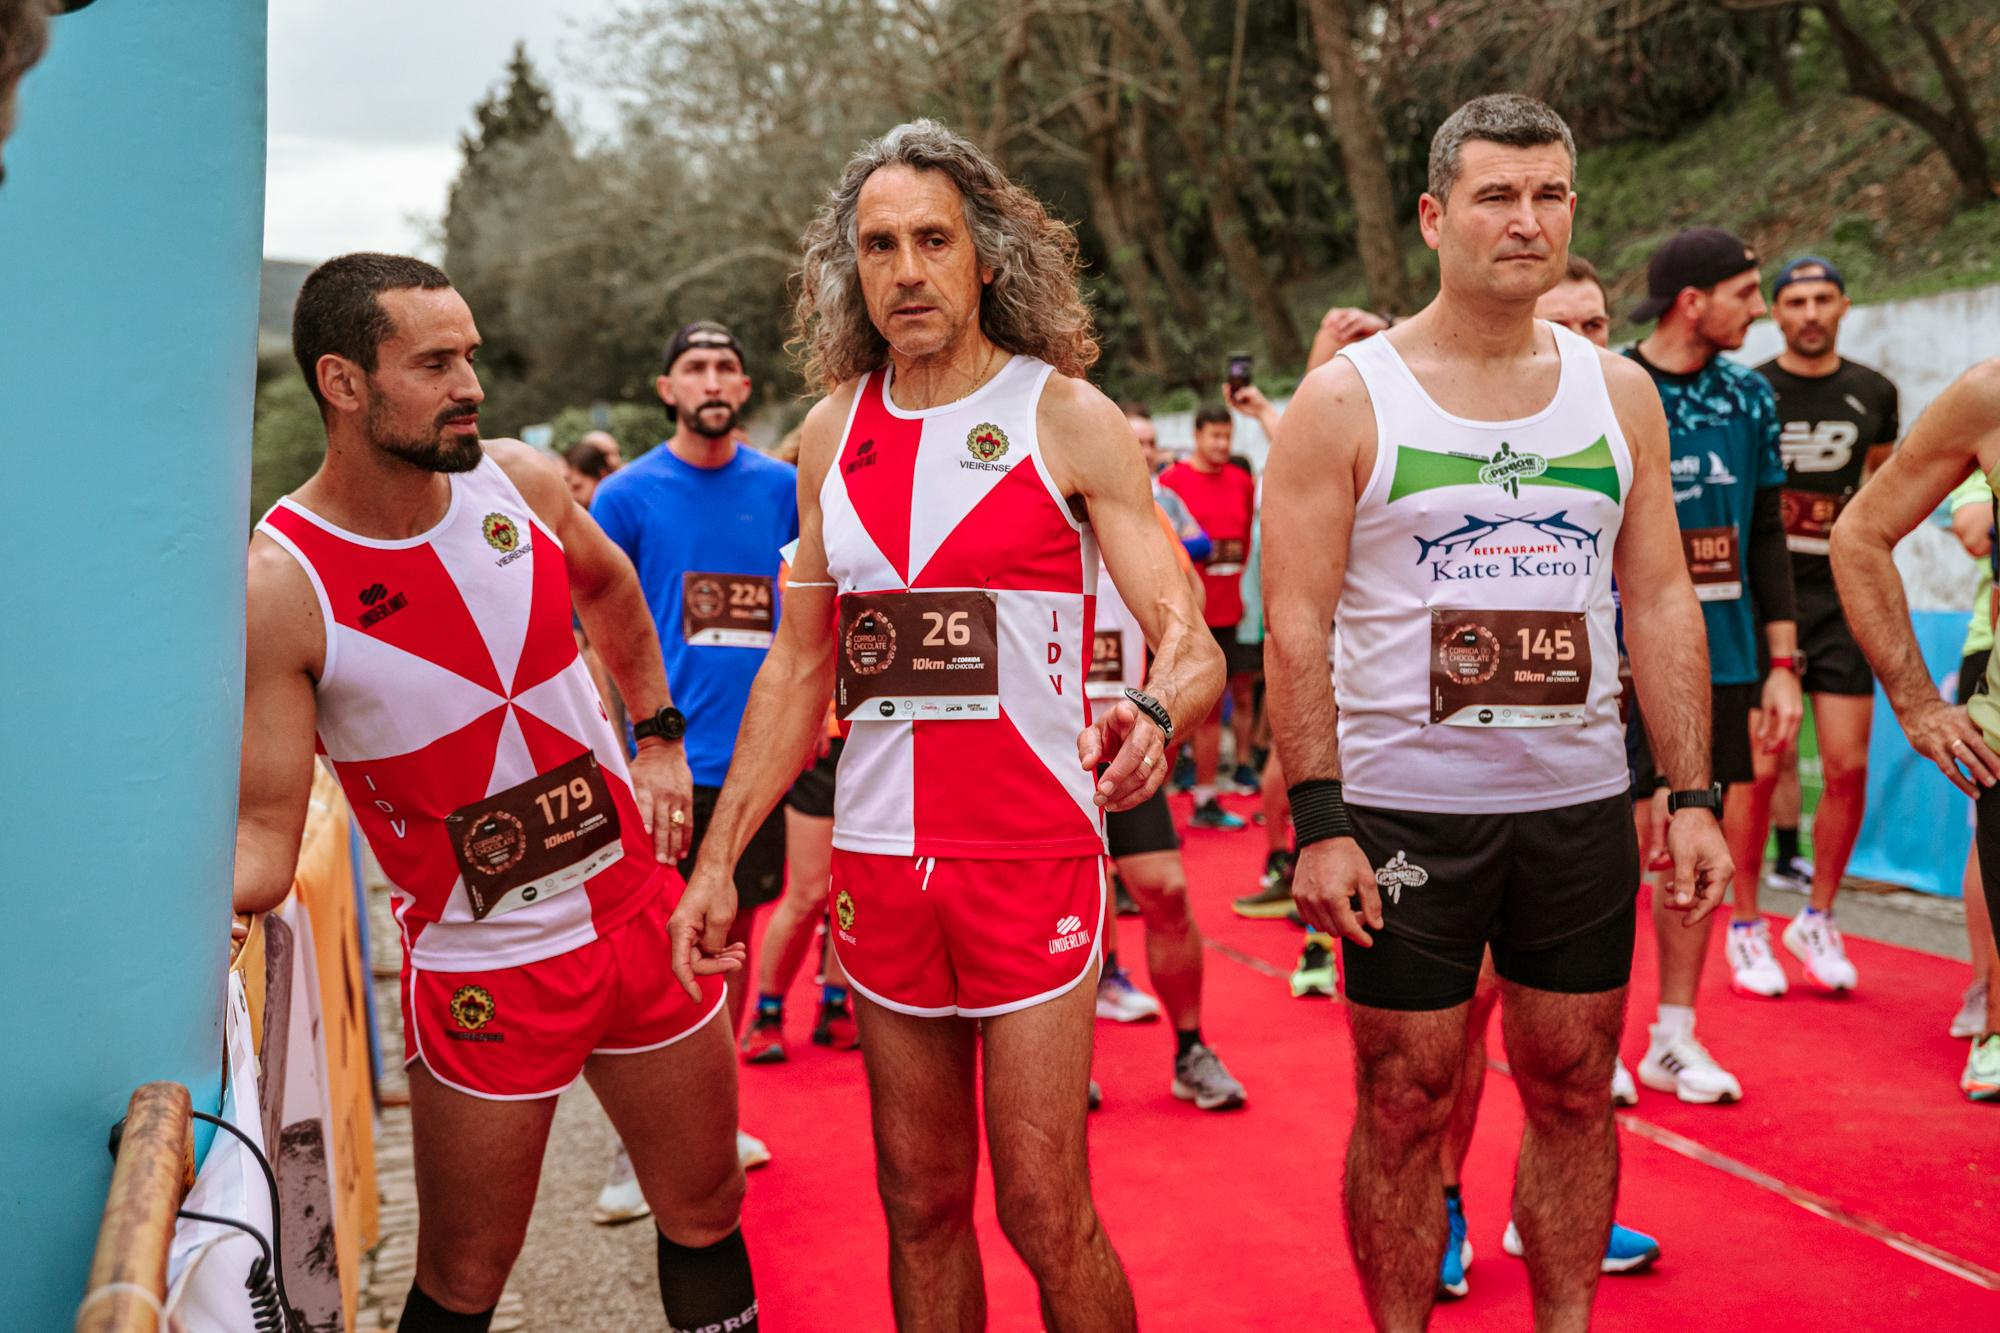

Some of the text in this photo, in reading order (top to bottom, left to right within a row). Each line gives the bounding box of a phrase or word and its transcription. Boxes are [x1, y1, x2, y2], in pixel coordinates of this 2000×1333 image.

[959, 460, 1012, 473] VIEIRENSE
[1490, 457, 1537, 479] PENICHE
[495, 543, 533, 568] VIEIRENSE
[1474, 544, 1559, 556] RESTAURANTE
[1691, 536, 1731, 560] 180
[1430, 559, 1501, 582] Kate
[1510, 555, 1577, 577] Kero
[729, 583, 770, 607] 224
[853, 635, 877, 643] CORRIDA
[922, 611, 970, 646] 26
[853, 642, 887, 651] CHOCOLATE
[1448, 647, 1479, 655] CORRIDA
[1517, 628, 1576, 661] 145
[912, 658, 945, 670] 10km
[1514, 669, 1546, 683] 10km
[535, 776, 593, 825] 179
[544, 830, 576, 850] 10km
